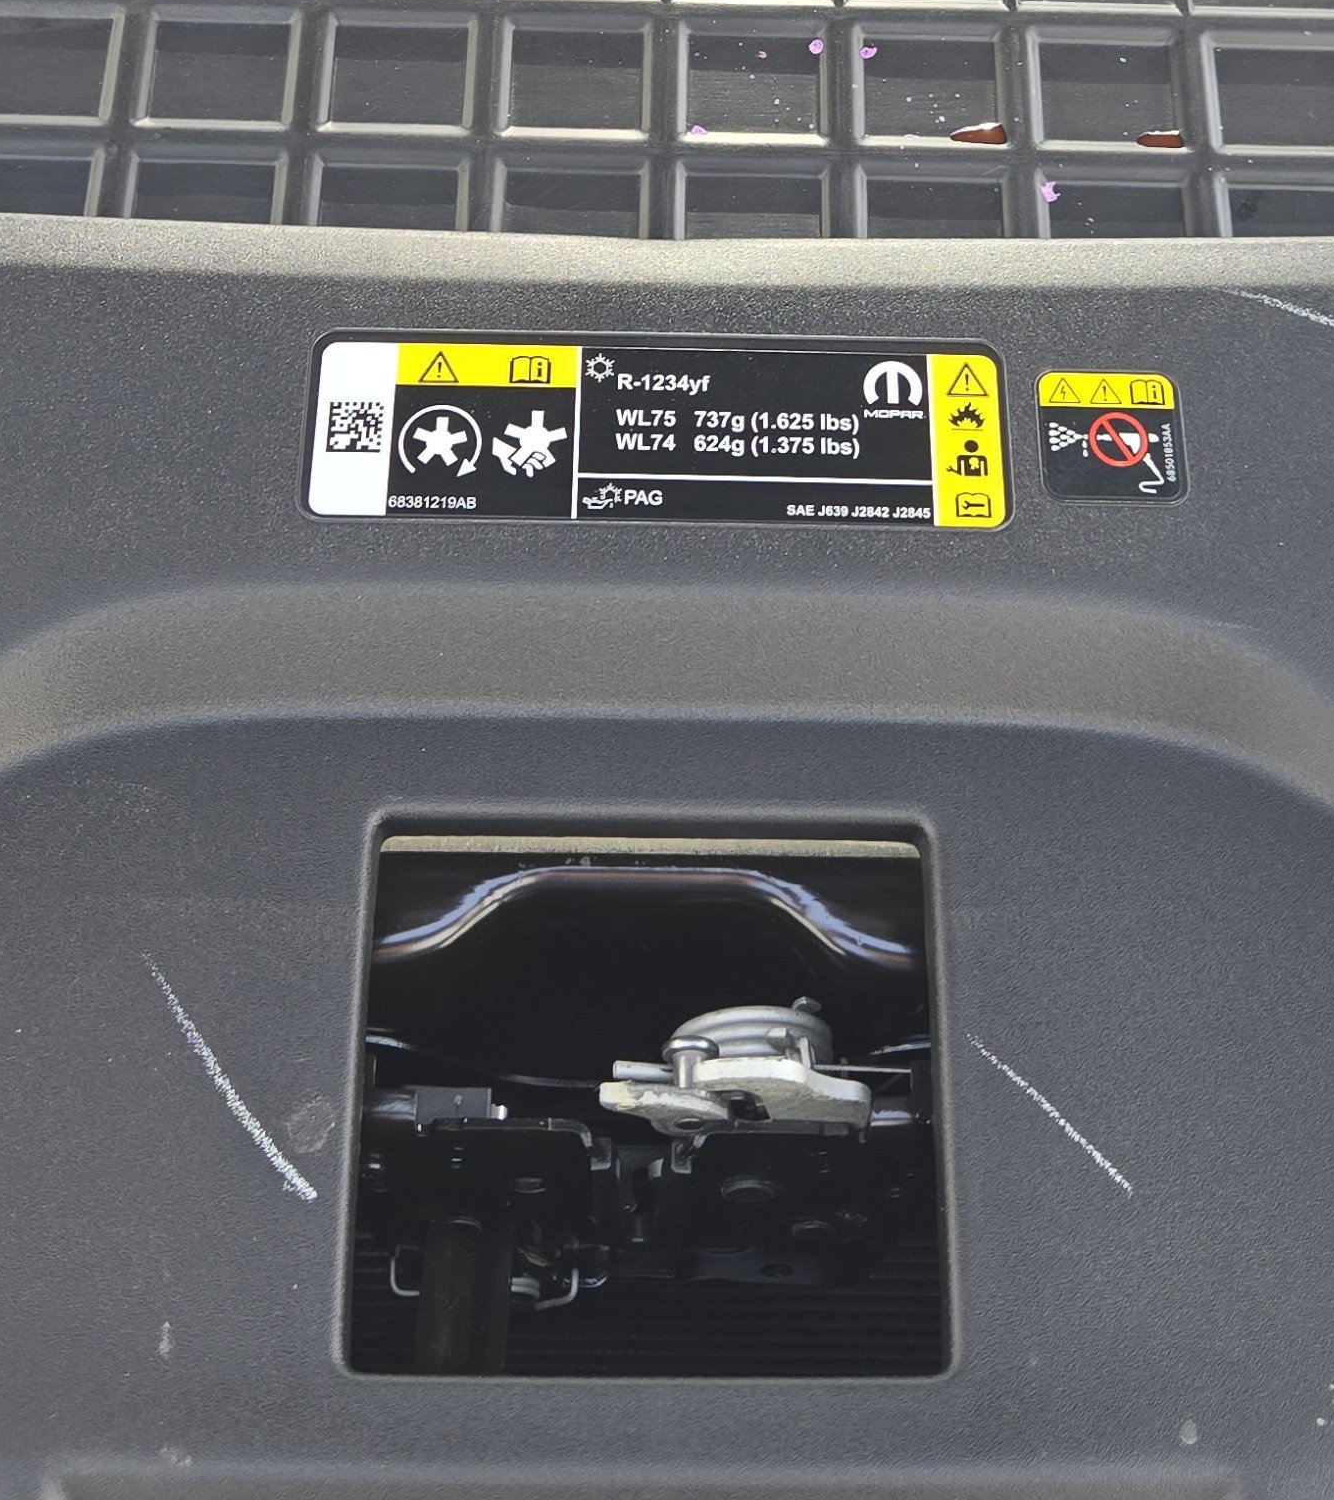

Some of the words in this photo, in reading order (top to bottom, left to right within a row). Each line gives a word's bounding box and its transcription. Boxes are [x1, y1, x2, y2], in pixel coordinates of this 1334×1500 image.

[617, 373, 711, 396] R-1234yf
[615, 408, 677, 427] WL75
[693, 410, 745, 433] 737g
[751, 412, 814, 433] (1.625
[820, 413, 860, 435] lbs)
[615, 432, 677, 451] WL74
[693, 434, 745, 457] 624g
[751, 435, 815, 457] (1.375
[820, 437, 860, 460] lbs)
[388, 495, 477, 510] 68381219AB
[624, 489, 664, 506] PAG
[786, 504, 815, 517] SAE
[817, 505, 849, 517] J639
[851, 505, 890, 518] J2842
[892, 506, 932, 519] J2845
